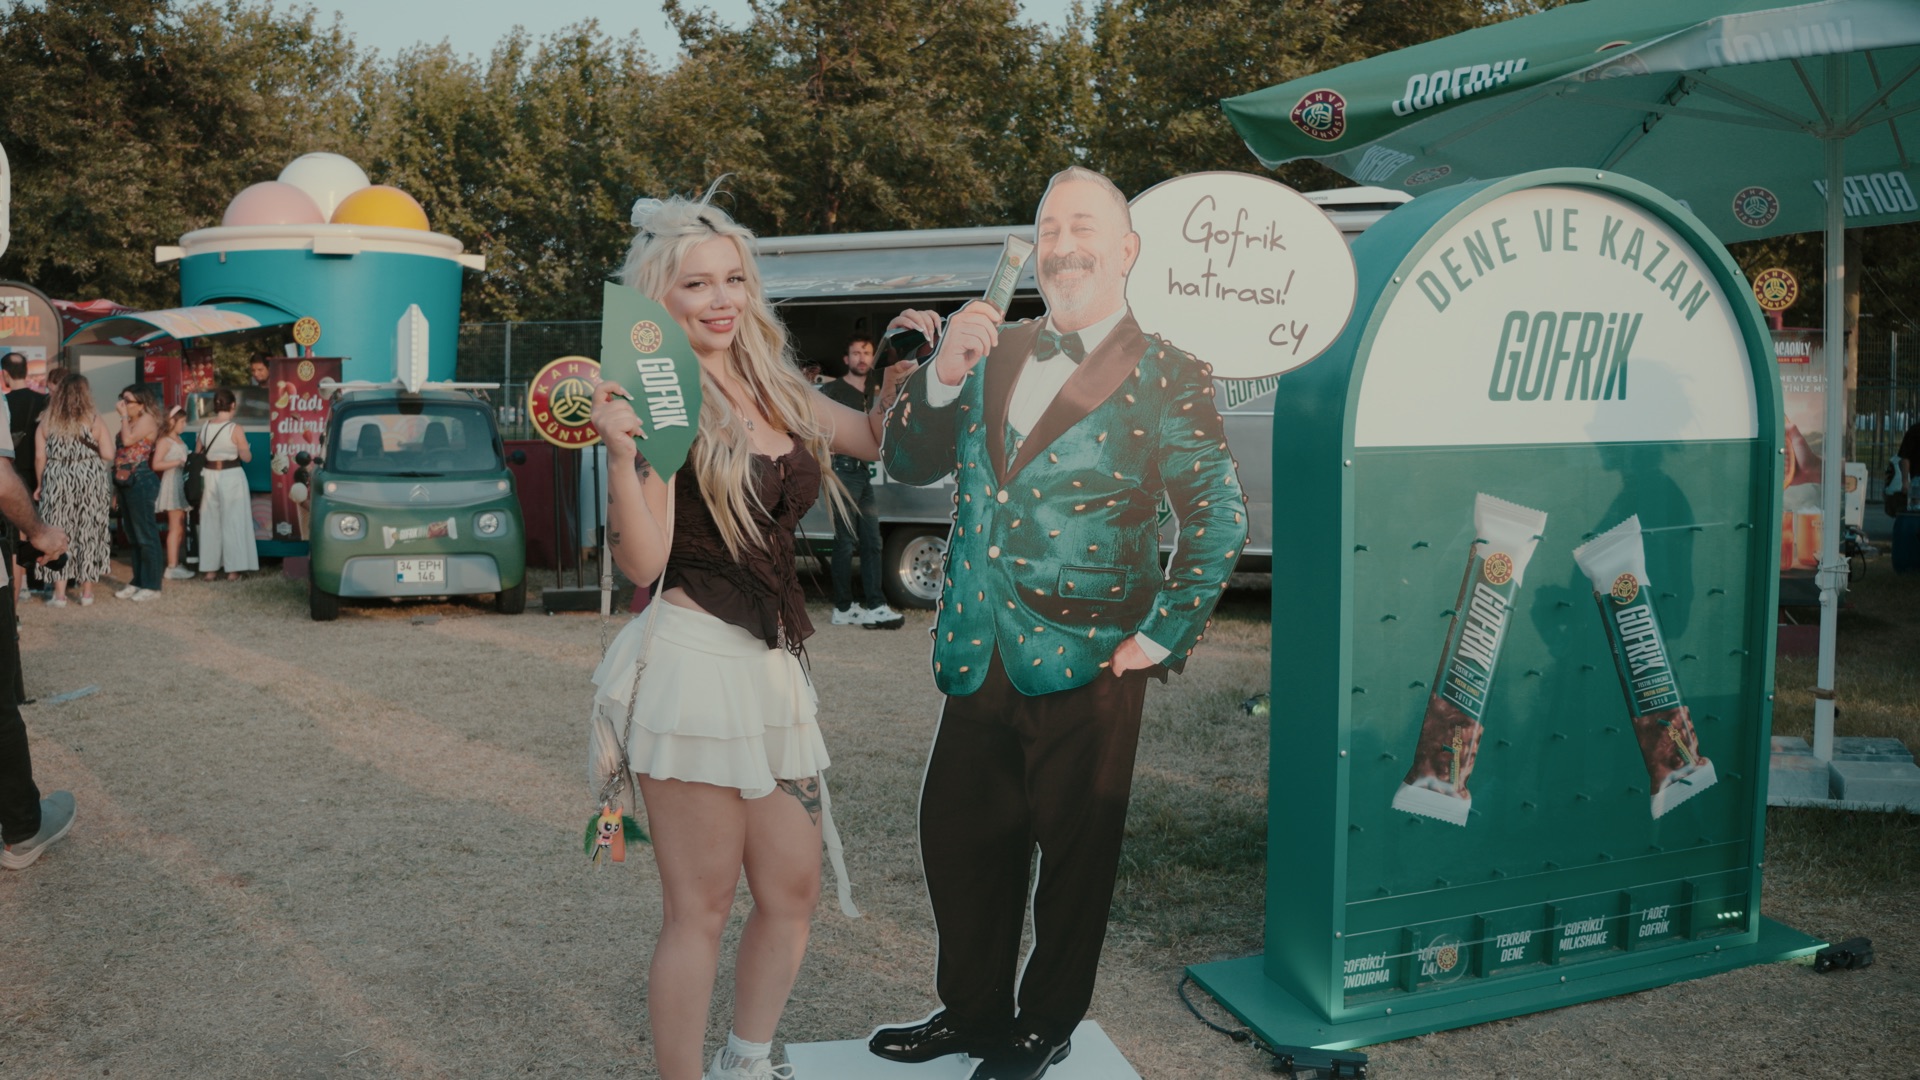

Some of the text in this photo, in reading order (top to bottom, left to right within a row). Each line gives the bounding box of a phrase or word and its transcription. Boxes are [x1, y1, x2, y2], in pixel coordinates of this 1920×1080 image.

[1294, 93, 1343, 115] KAHVE
[1182, 194, 1287, 268] Gofrik
[1415, 207, 1711, 322] DENE VE KAZAN
[538, 363, 600, 394] KAHV
[289, 394, 324, 411] Tadı
[400, 561, 441, 571] 34 EPH
[418, 571, 435, 581] 146
[1647, 905, 1670, 920] ADET
[1639, 919, 1670, 938] GOFRİK
[1496, 931, 1531, 948] TEKRAR
[1559, 931, 1609, 951] MILKSHAKE
[1500, 946, 1525, 963] DENE
